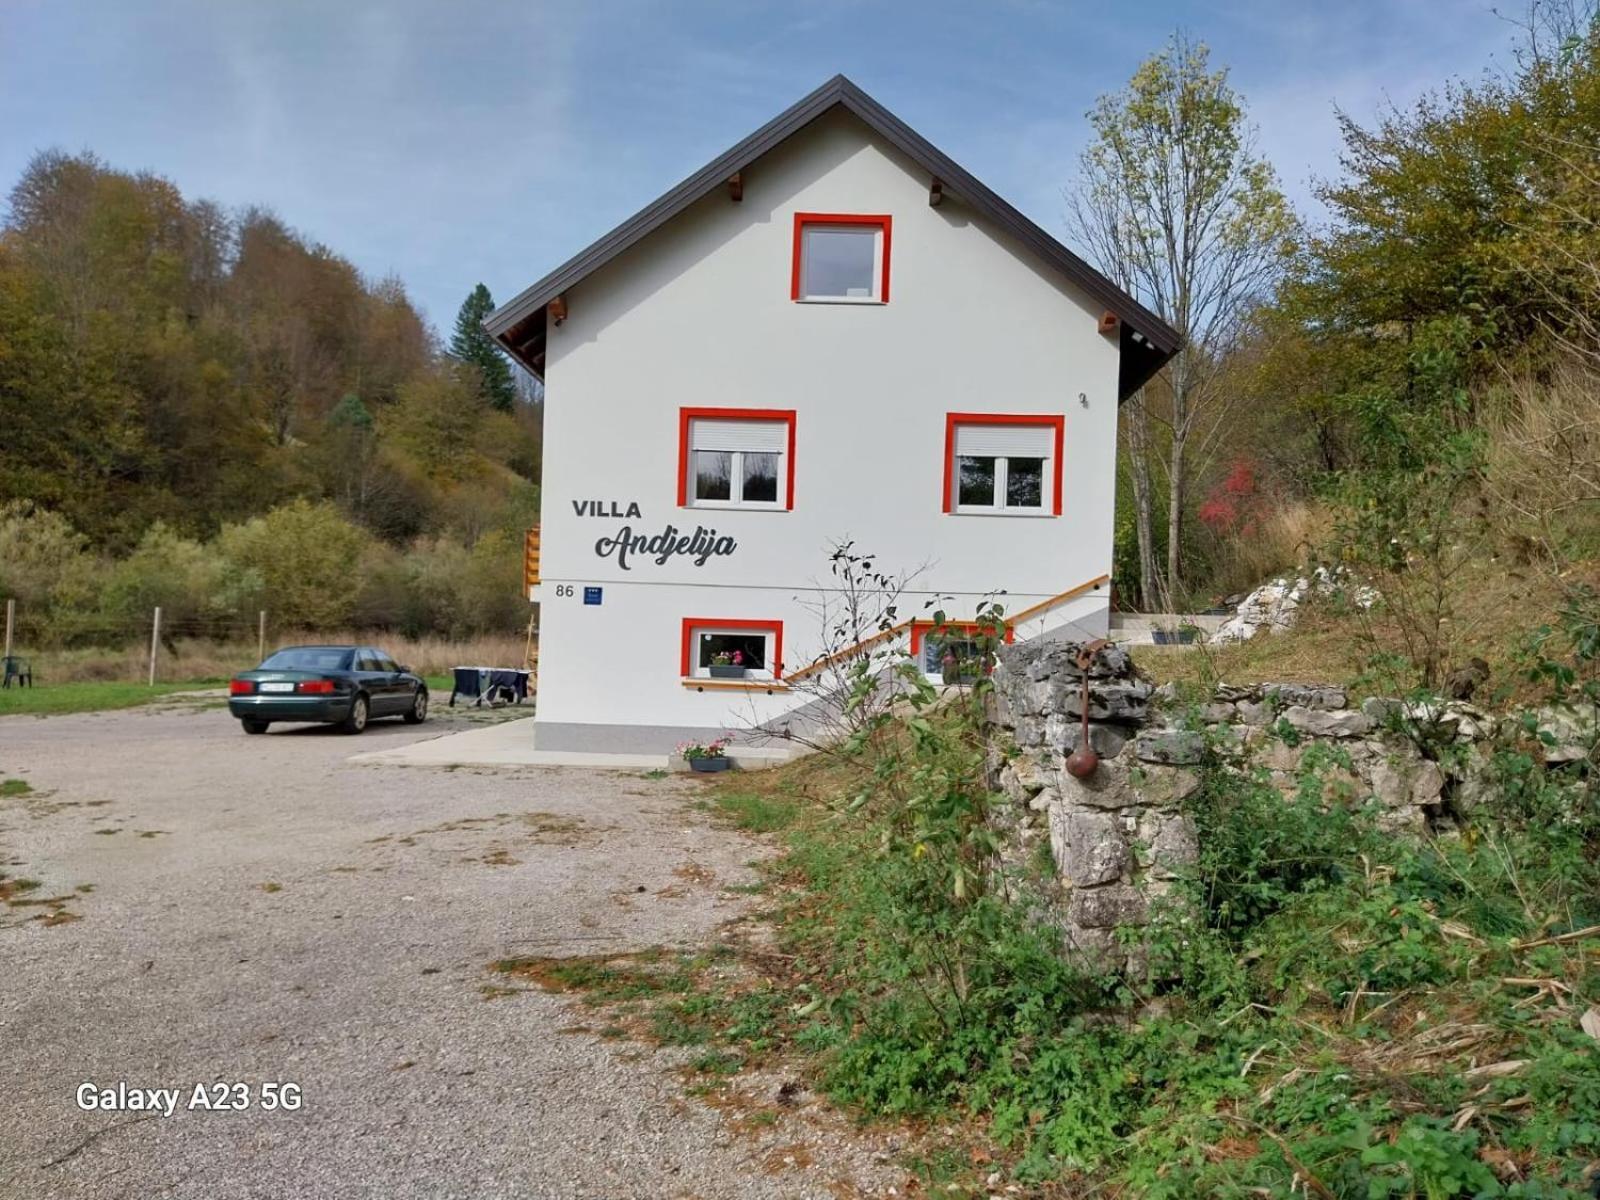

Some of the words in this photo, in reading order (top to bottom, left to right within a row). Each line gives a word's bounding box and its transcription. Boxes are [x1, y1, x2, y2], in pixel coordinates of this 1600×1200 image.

[572, 500, 642, 519] VILLA
[595, 525, 737, 571] Andjelija
[556, 584, 574, 598] 86
